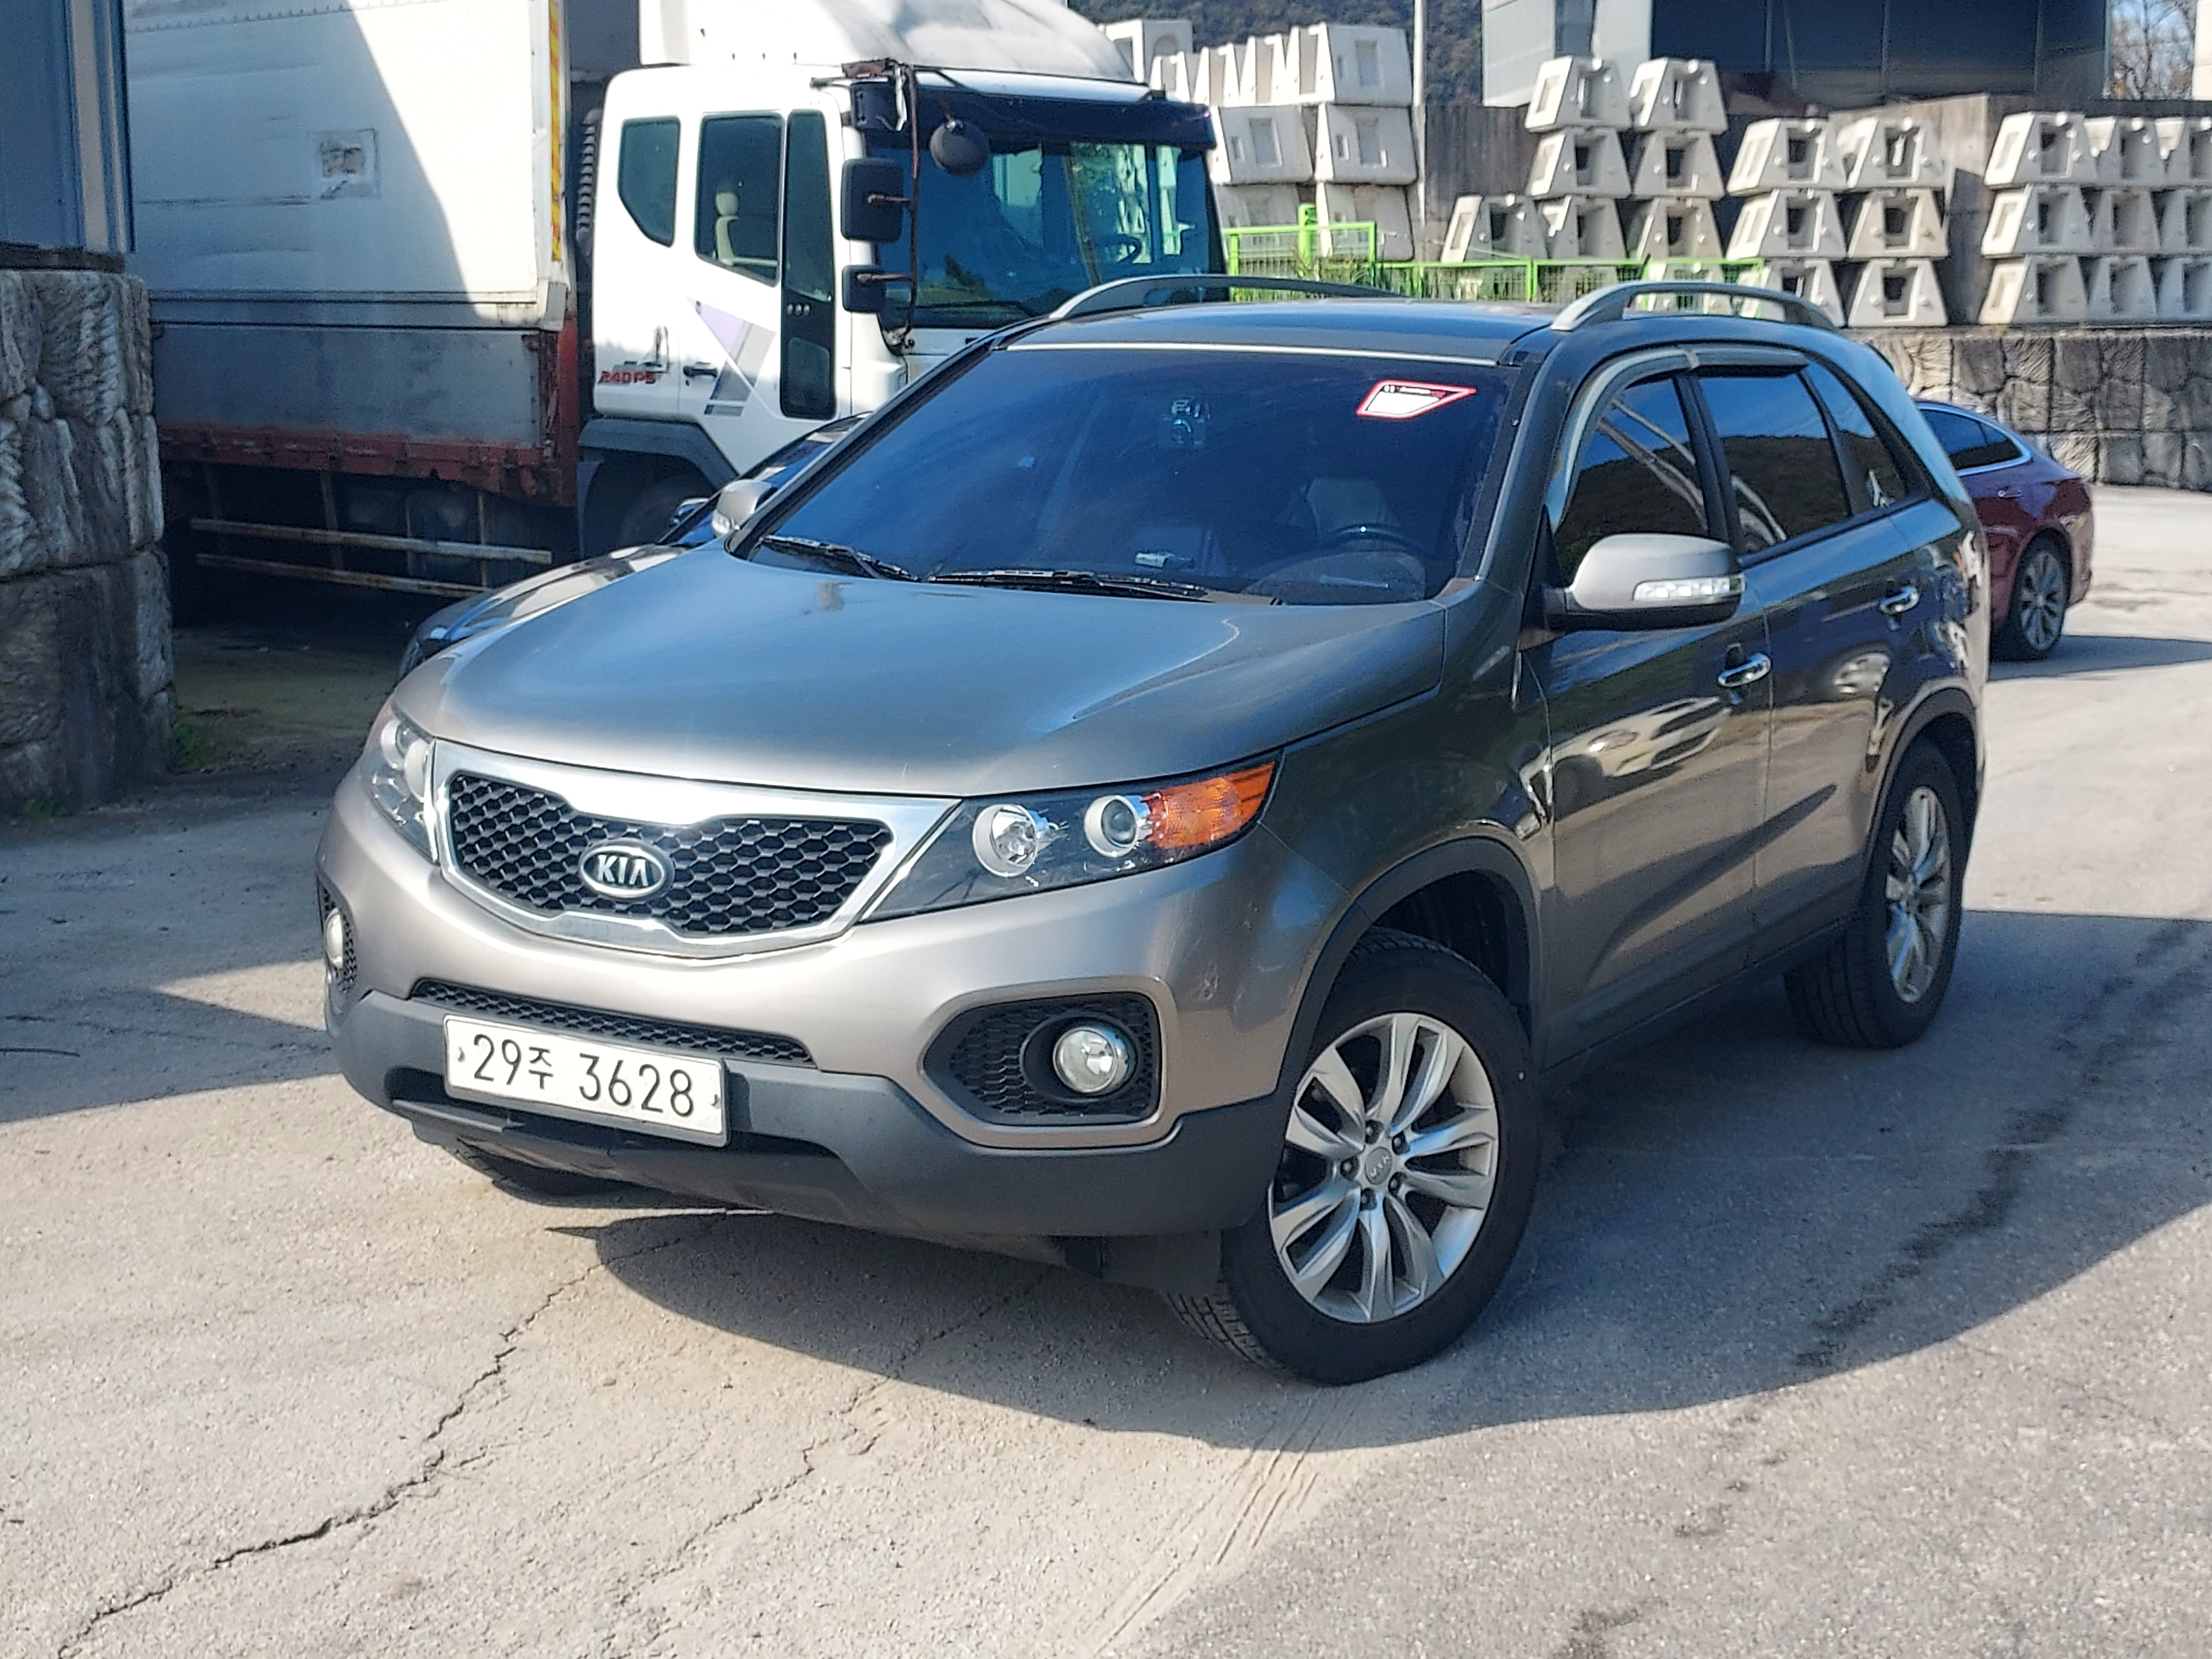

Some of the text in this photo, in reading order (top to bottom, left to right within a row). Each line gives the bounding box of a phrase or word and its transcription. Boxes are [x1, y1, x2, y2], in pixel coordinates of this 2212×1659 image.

[598, 854, 648, 886] KIA
[473, 1034, 693, 1117] 29주 3628
